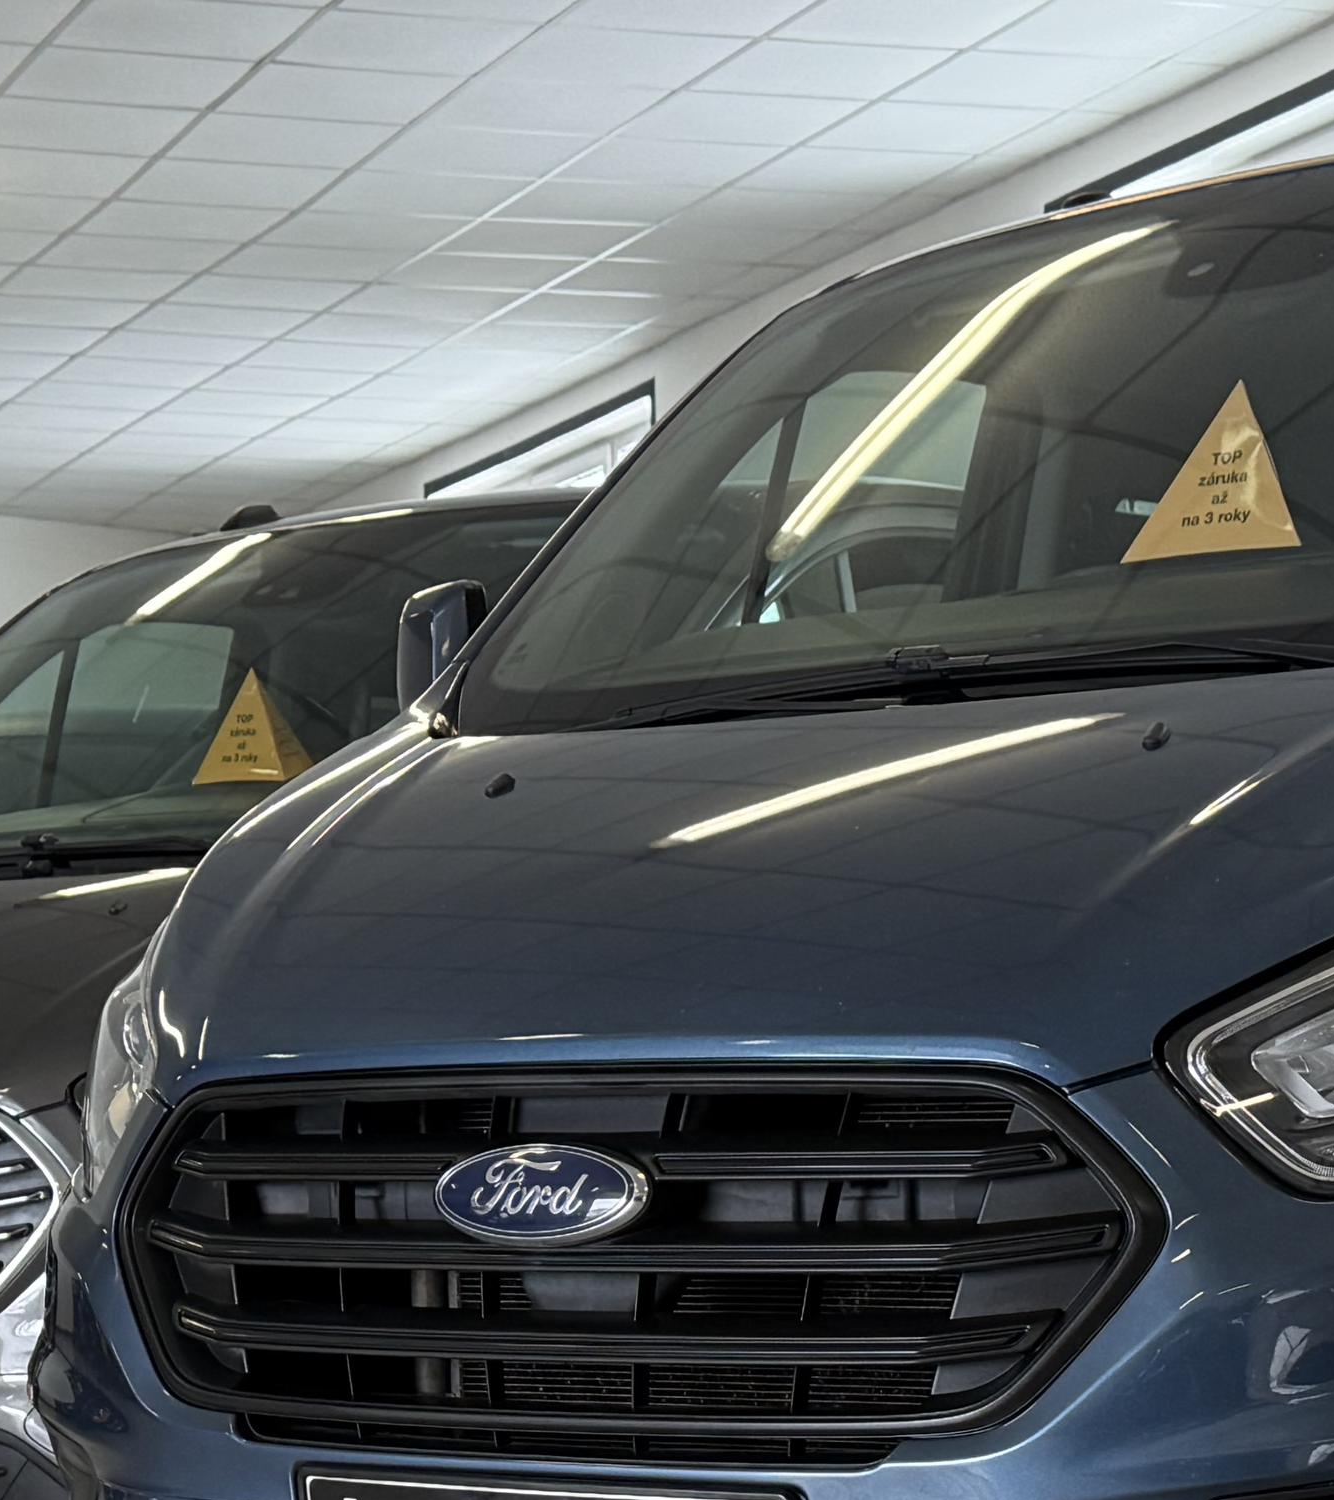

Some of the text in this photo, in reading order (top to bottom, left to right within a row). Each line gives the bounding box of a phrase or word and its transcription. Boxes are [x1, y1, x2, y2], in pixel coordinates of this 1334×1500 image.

[1212, 450, 1243, 465] TOP
[1198, 471, 1248, 487] záruka
[1211, 491, 1228, 505] až
[1181, 508, 1251, 527] na 3 roky
[470, 1157, 589, 1216] Ford
